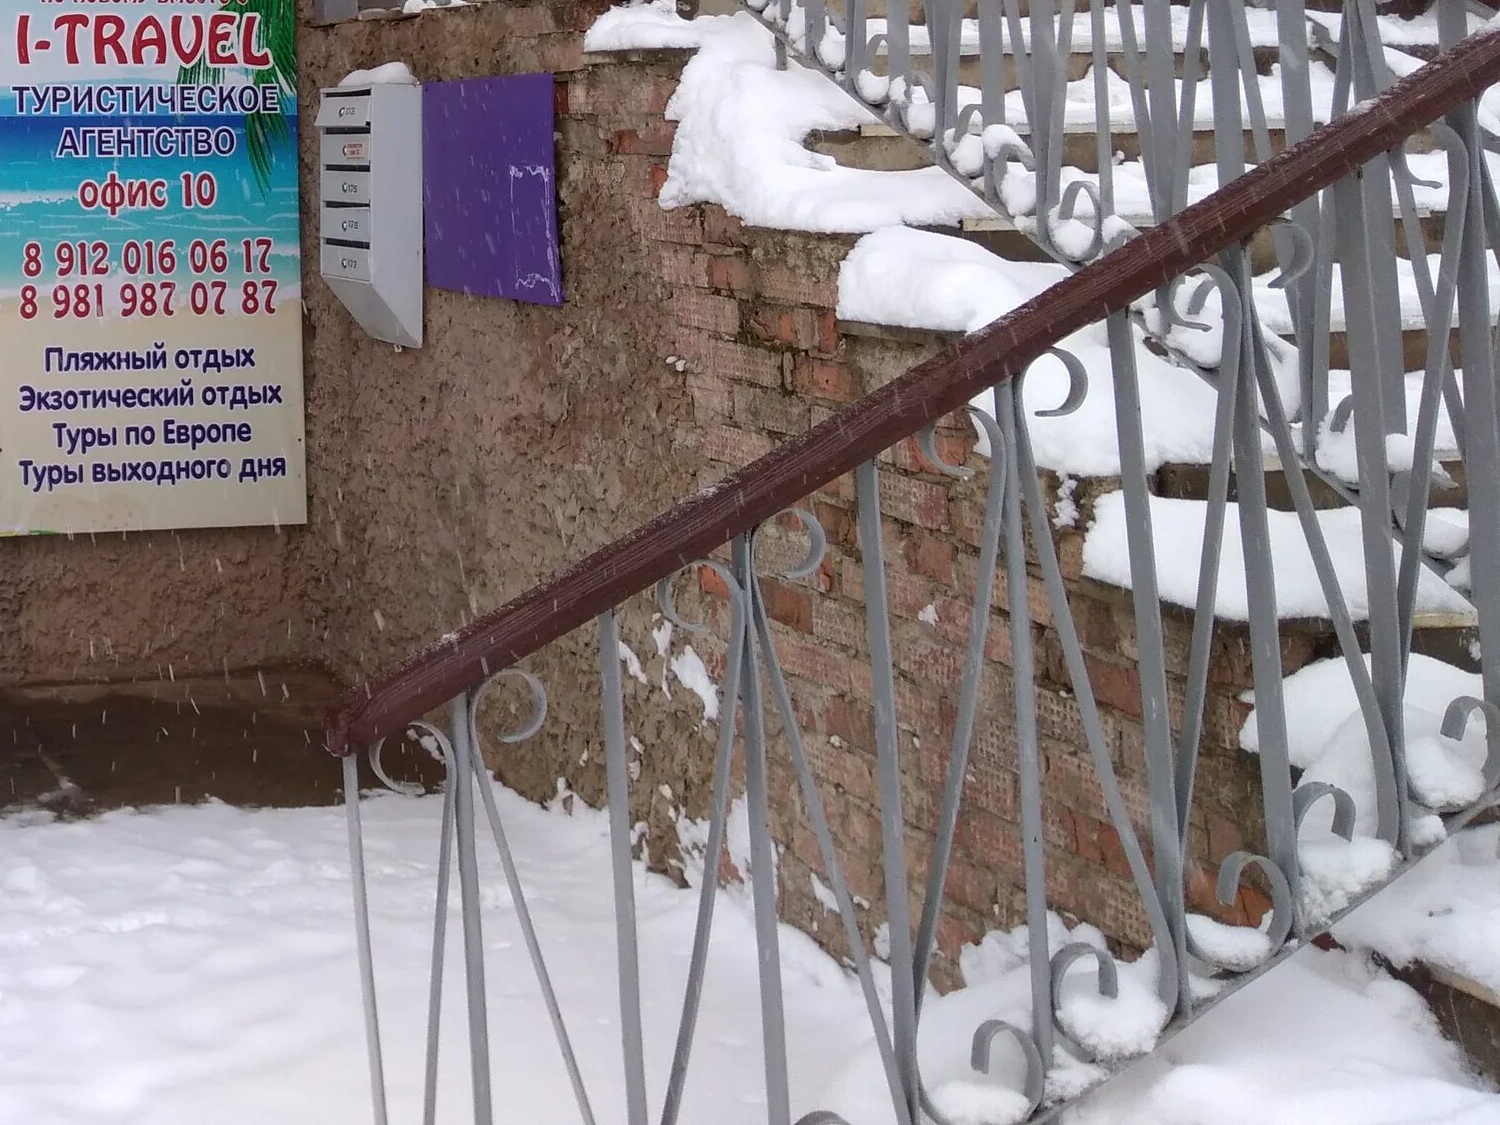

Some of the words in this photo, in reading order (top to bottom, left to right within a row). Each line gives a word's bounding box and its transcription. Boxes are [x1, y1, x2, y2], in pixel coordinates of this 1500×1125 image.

[15, 12, 273, 68] I-TRAVEL
[11, 84, 280, 115] ТУРИСТИЧЕСКОЕ
[56, 126, 236, 157] АГЕНТСТВО
[78, 171, 167, 216] офис
[181, 171, 218, 209] 10
[23, 242, 42, 277] 8
[55, 240, 110, 277] 912
[122, 239, 177, 275] 016
[188, 239, 228, 275] 06
[242, 238, 273, 273] 17
[19, 284, 38, 320] 8
[52, 282, 104, 319] 981
[119, 281, 176, 318] 987
[189, 280, 227, 316] 07
[241, 279, 278, 315] 87
[44, 341, 167, 373] Пляжный
[174, 346, 256, 373] отдых
[18, 379, 194, 411] Экзотический
[202, 383, 283, 410] отдых
[52, 422, 117, 455] Туры
[124, 426, 156, 446] по
[162, 419, 252, 450] Европе
[18, 459, 84, 492] Туры
[91, 459, 232, 486] выходного
[238, 457, 286, 483] дня
